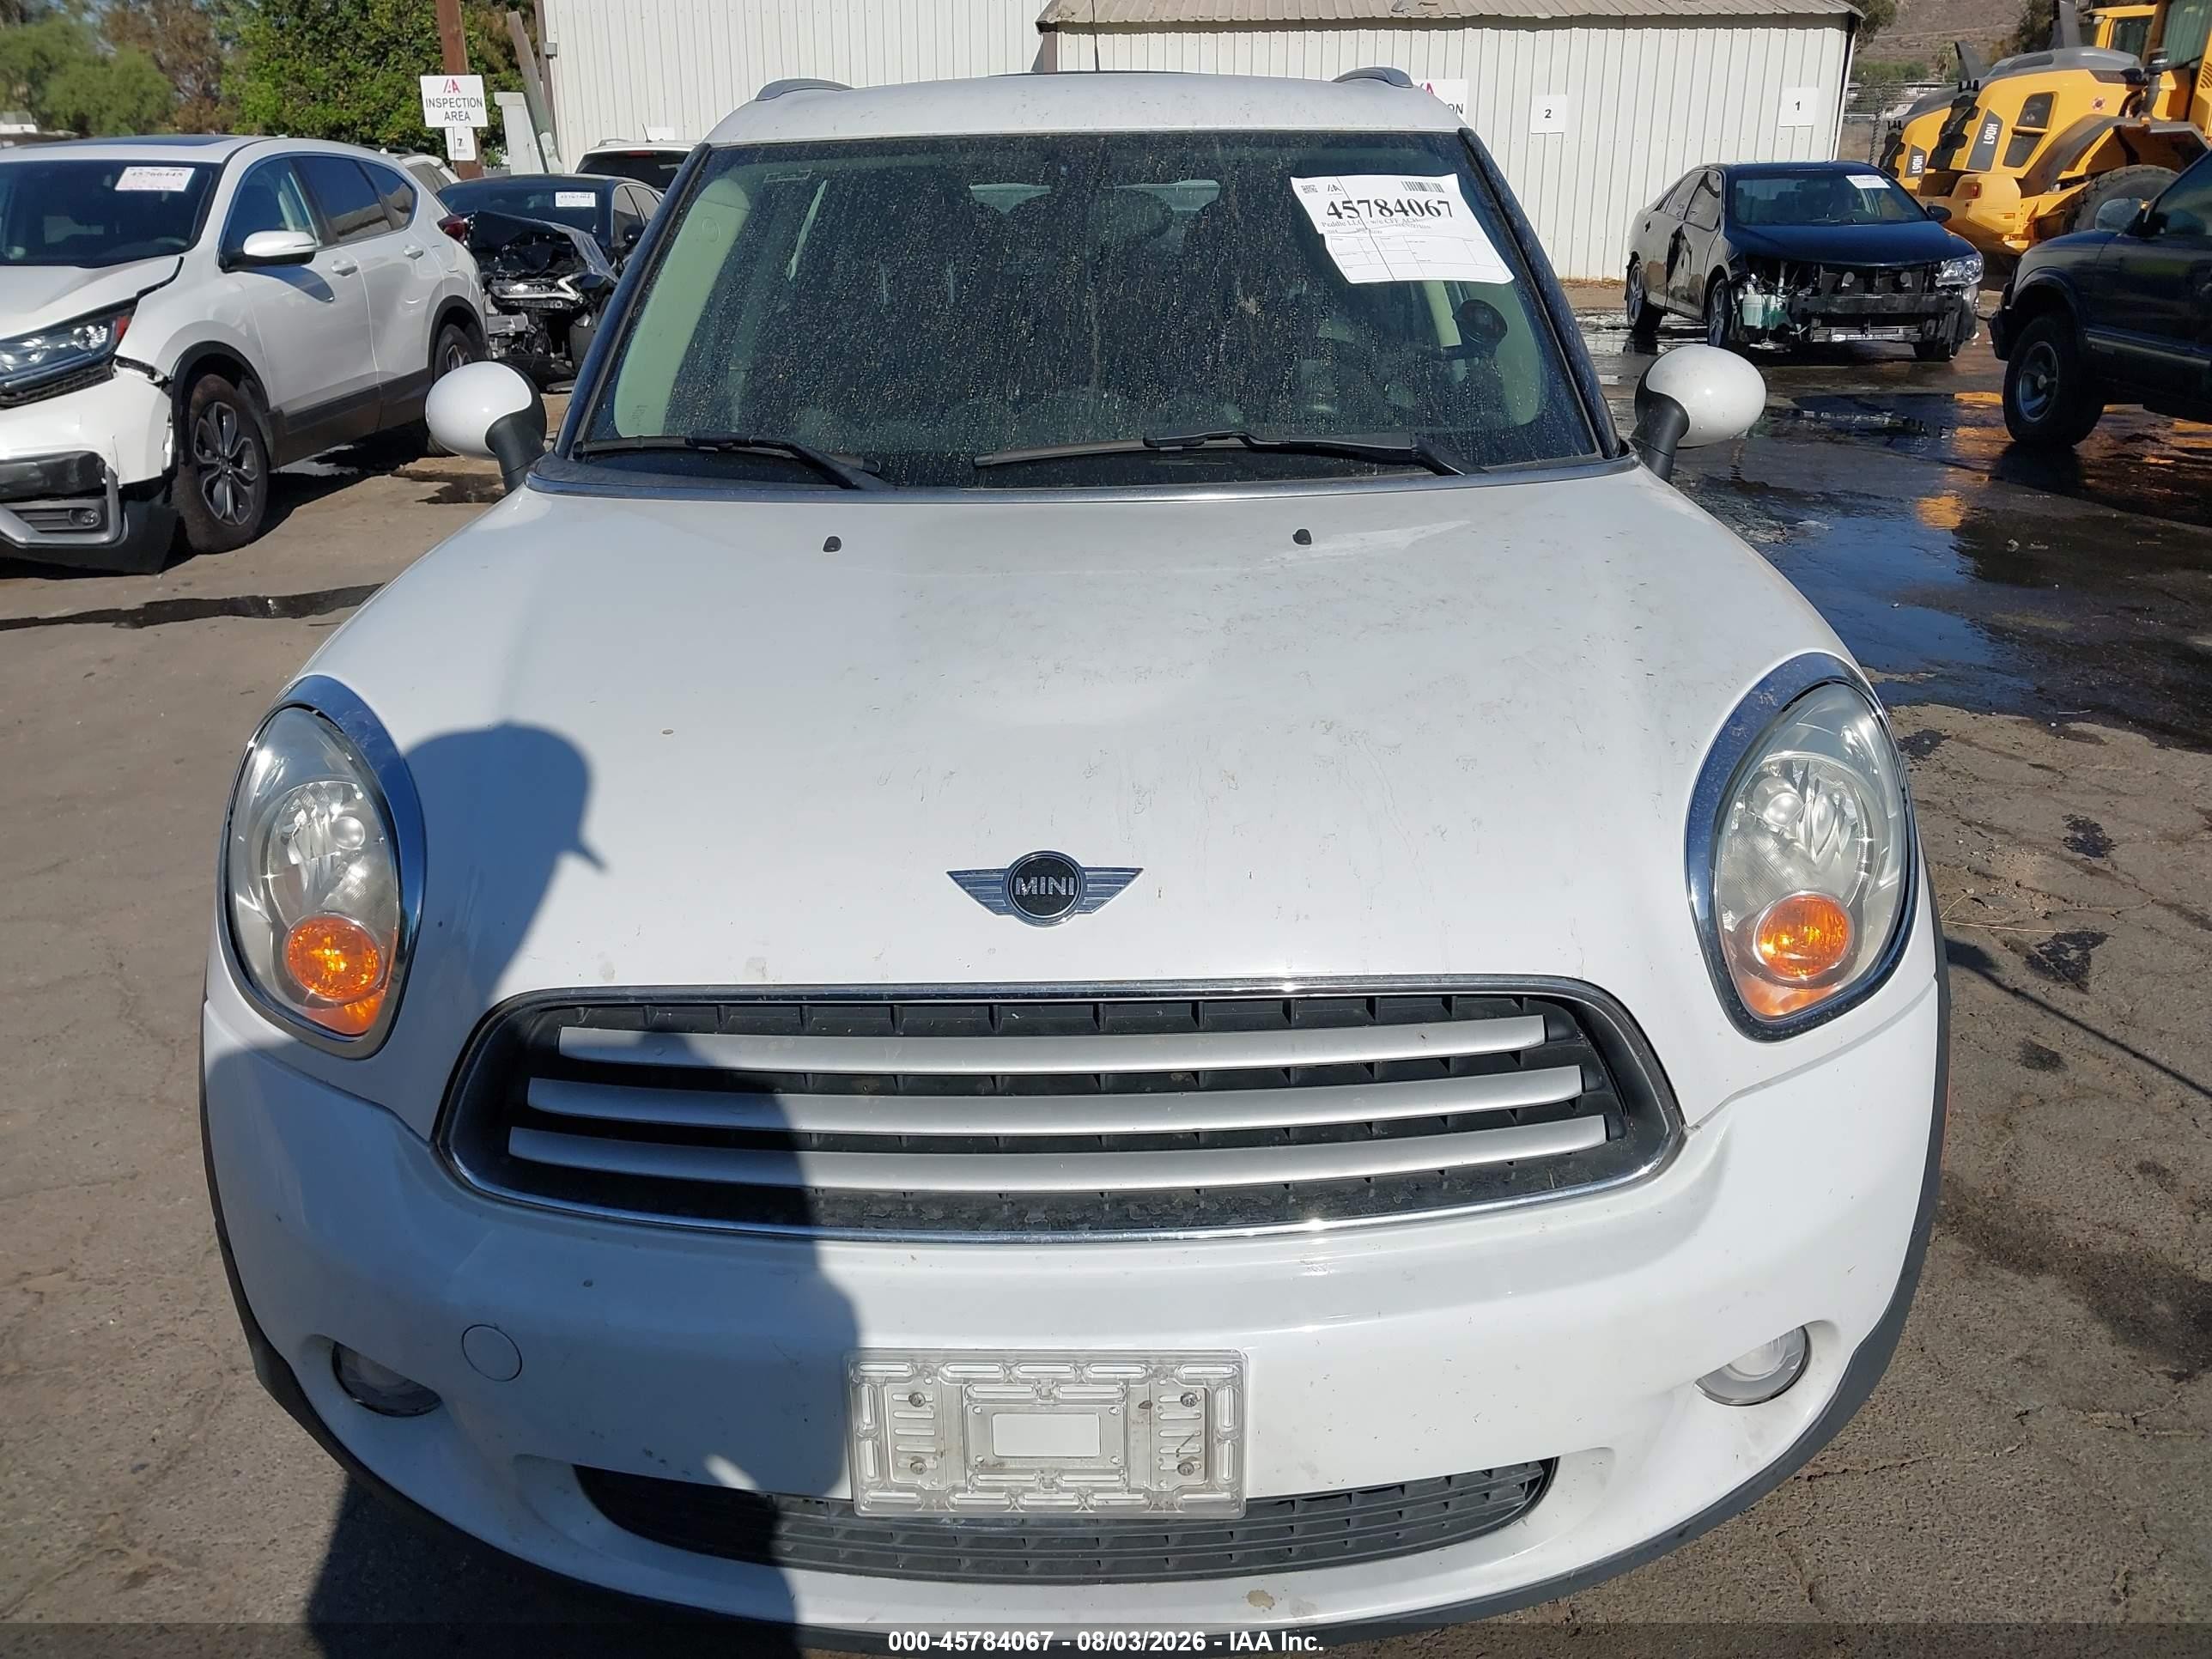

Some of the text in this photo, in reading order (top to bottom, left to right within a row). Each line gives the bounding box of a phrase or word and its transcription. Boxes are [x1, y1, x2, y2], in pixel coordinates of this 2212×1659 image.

[426, 97, 483, 108] INSPECTION
[1795, 100, 1801, 111] 1
[444, 111, 471, 121] AREA
[1544, 109, 1552, 118] 2
[1983, 123, 1999, 145] L90H
[457, 138, 463, 147] 7
[1911, 155, 1923, 173] L90H
[1327, 198, 1453, 219] 45784067
[1015, 877, 1074, 896] MINI
